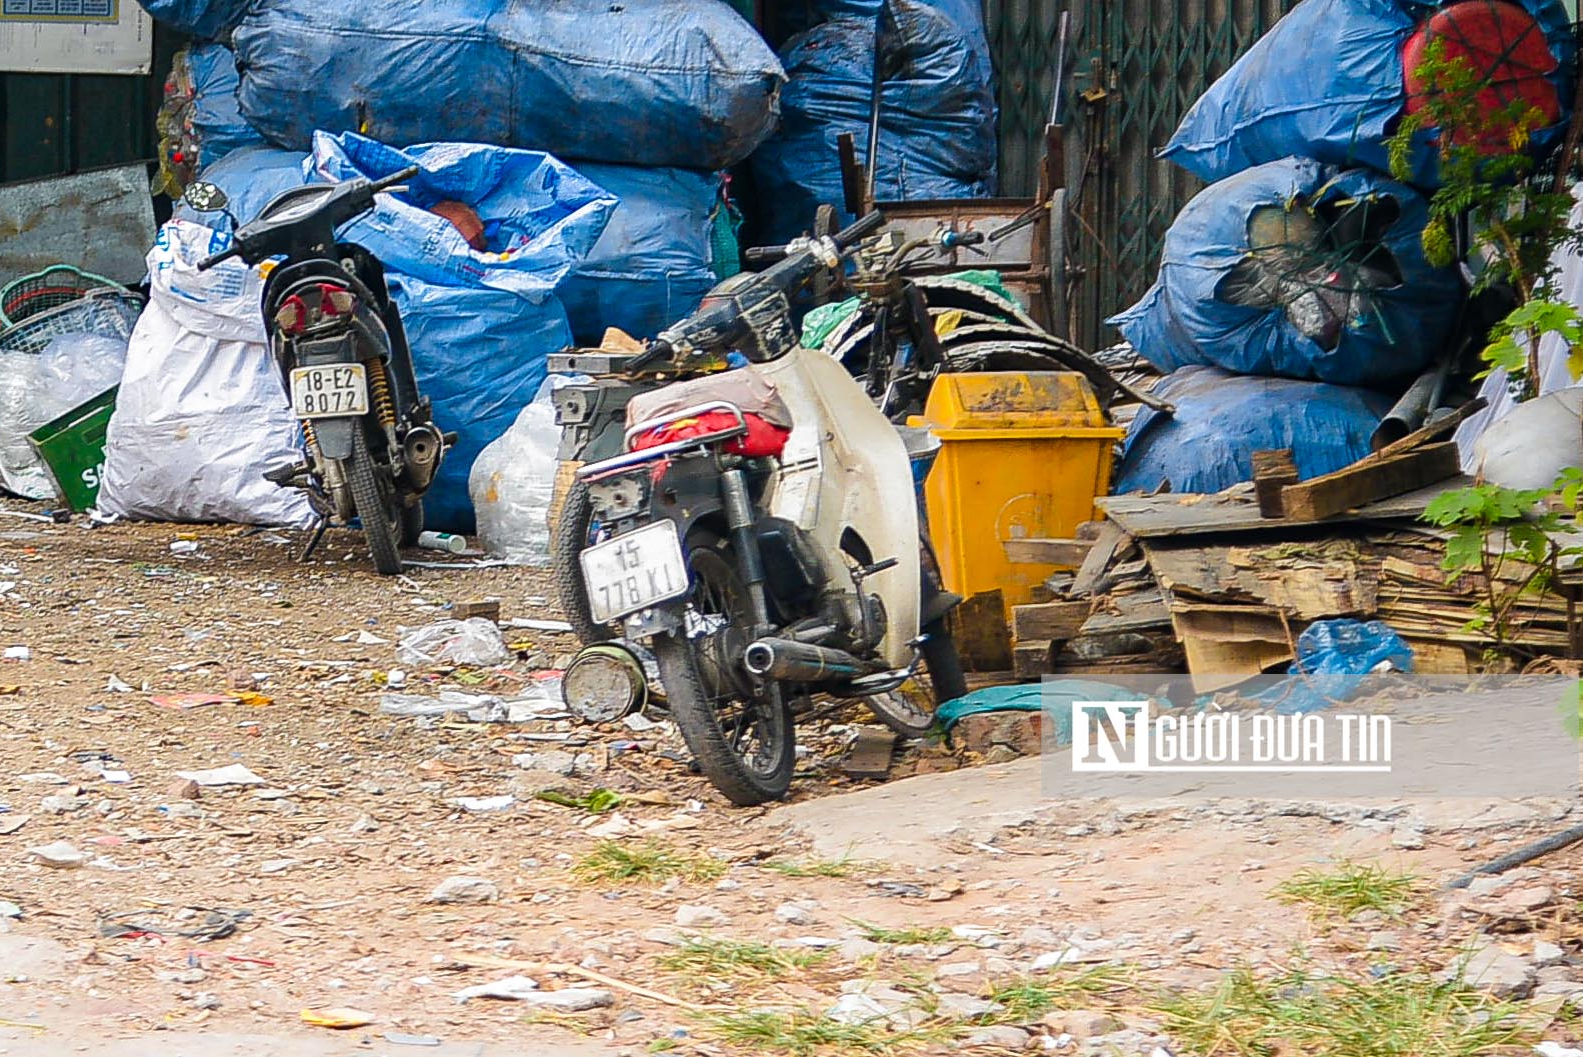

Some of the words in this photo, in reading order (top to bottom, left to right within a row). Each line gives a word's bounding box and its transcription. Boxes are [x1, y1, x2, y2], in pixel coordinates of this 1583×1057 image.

[305, 368, 355, 391] 18-E2
[304, 391, 357, 413] 8072
[615, 539, 640, 571] 15
